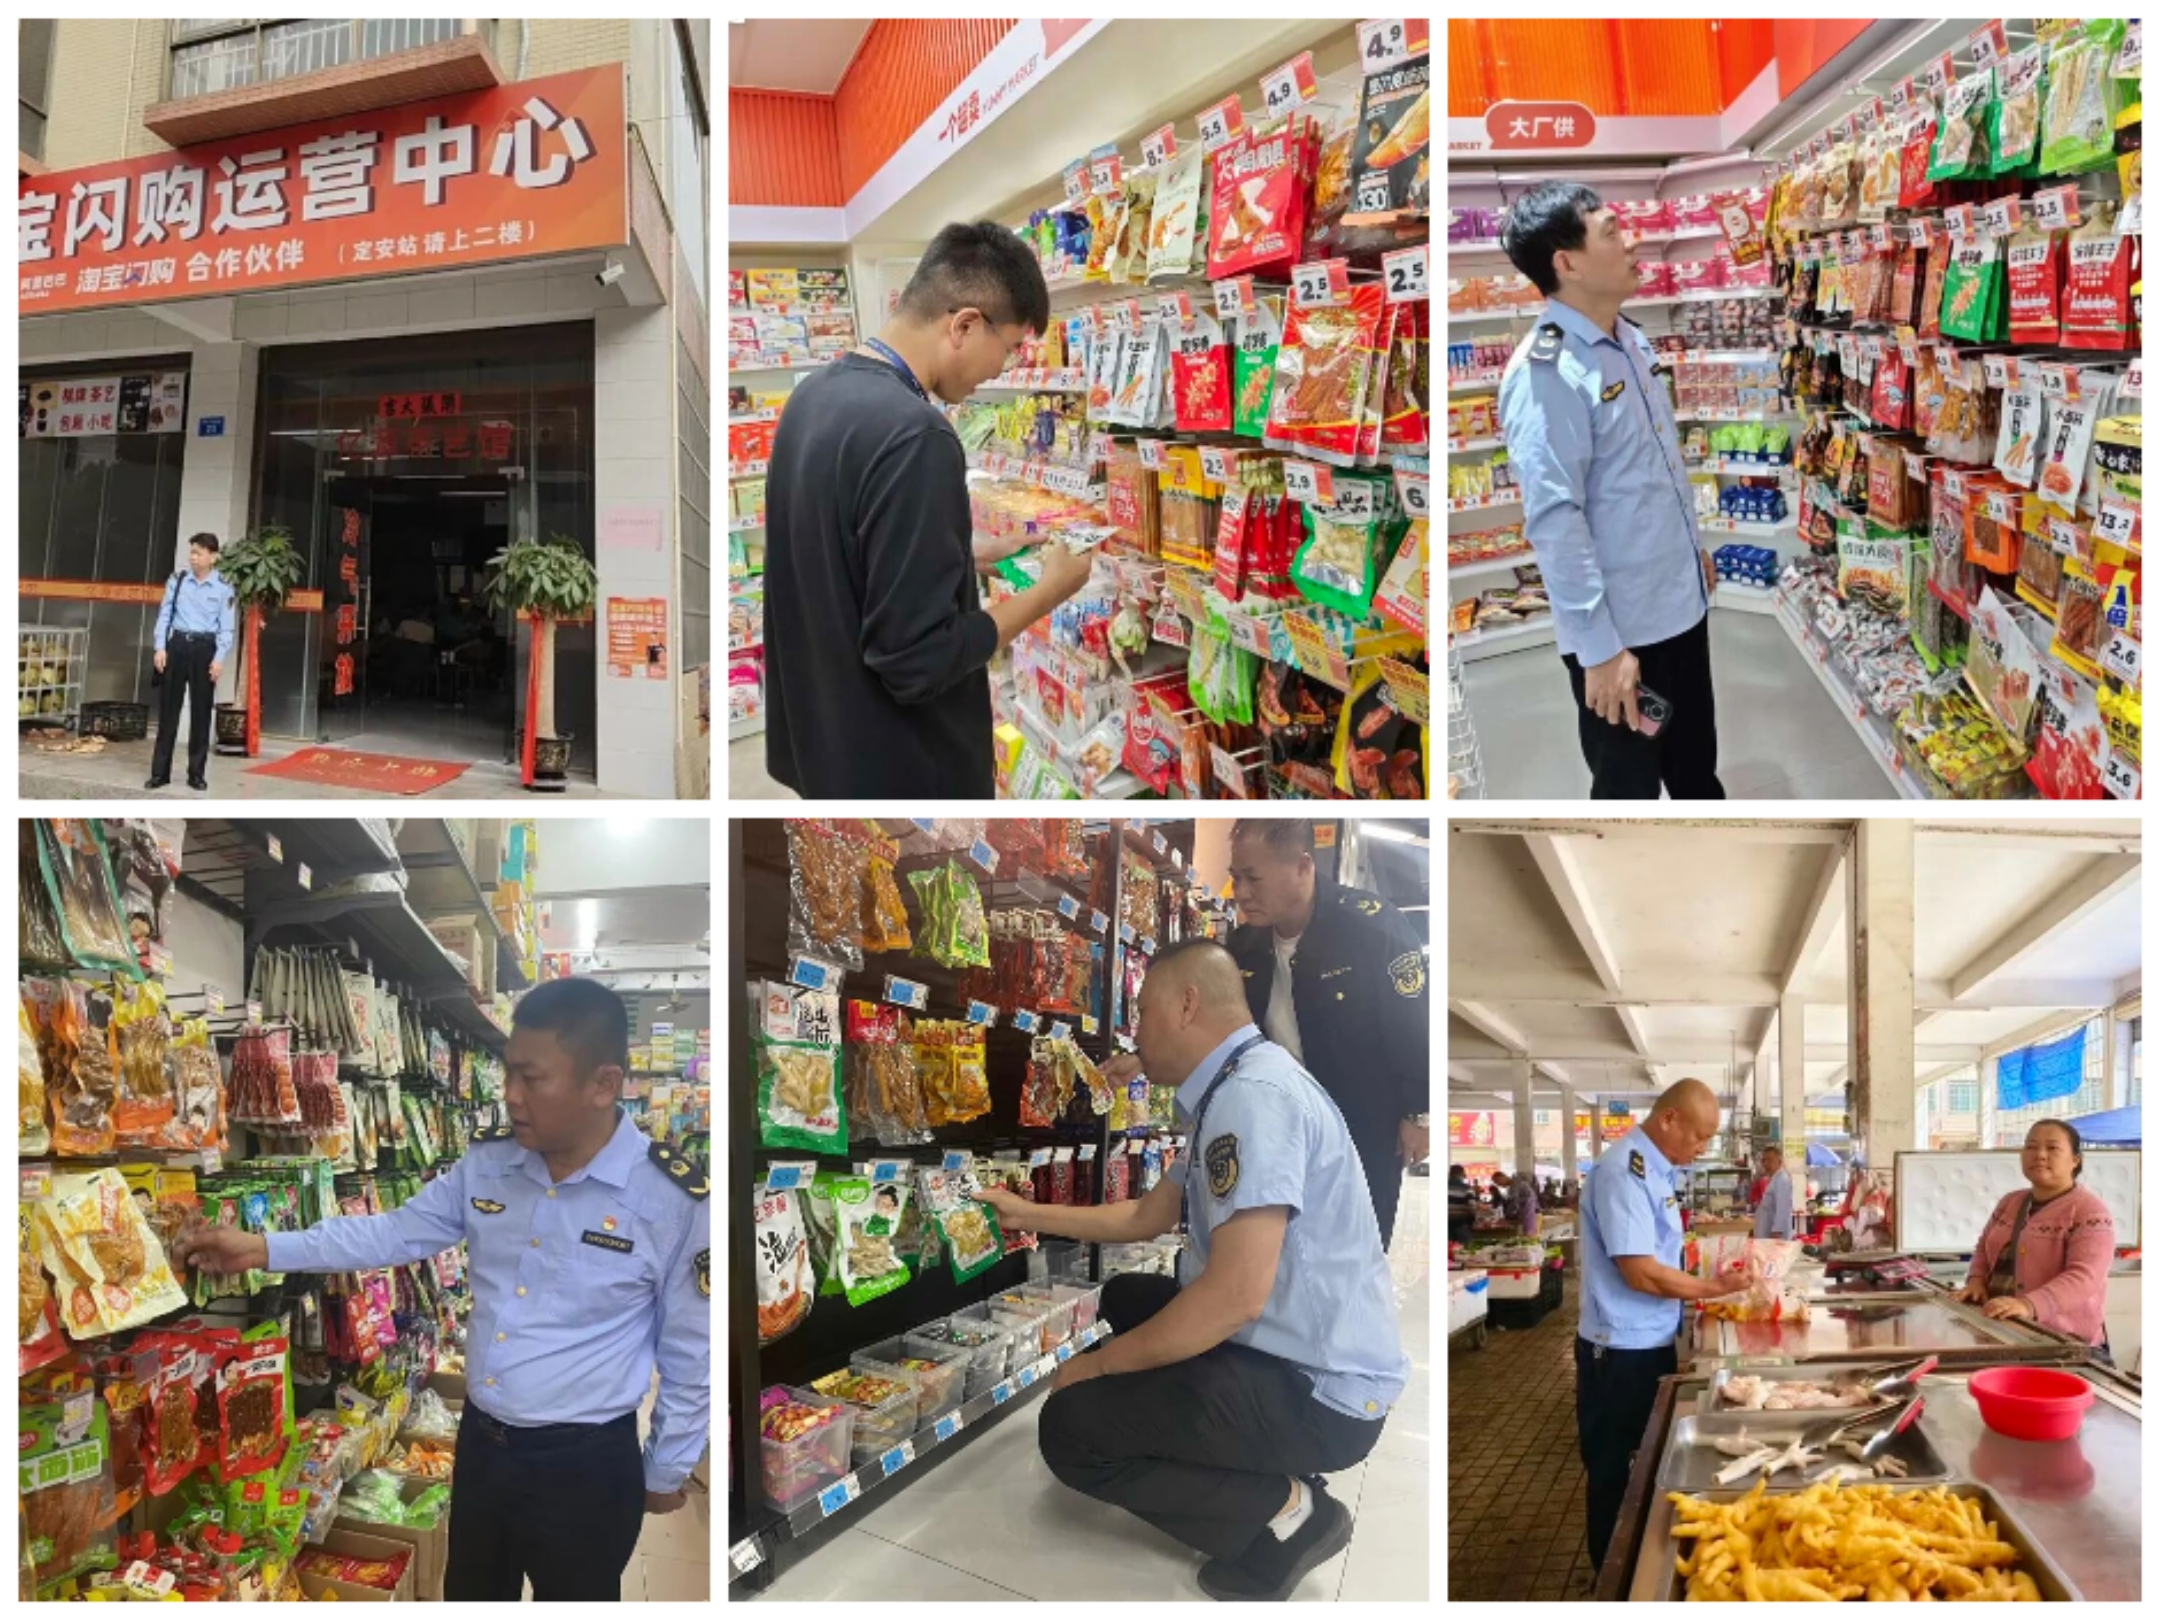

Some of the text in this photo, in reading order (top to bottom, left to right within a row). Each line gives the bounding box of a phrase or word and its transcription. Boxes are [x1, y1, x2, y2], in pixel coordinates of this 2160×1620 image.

[1366, 24, 1401, 58] 4.9
[1268, 82, 1290, 106] 4.9
[1201, 121, 1221, 141] 5.5
[1509, 116, 1575, 138] 大厂供
[2037, 201, 2057, 217] 2.5
[76, 239, 305, 295] 淘宝闪购 合作伙伴
[1390, 262, 1424, 292] 2.5
[1300, 277, 1327, 302] 2.5
[89, 385, 116, 403] 茶艺
[87, 412, 113, 431] 小吃
[1286, 473, 1310, 489] 2.9
[2109, 641, 2136, 664] 2.6
[2107, 760, 2131, 787] 3.6
